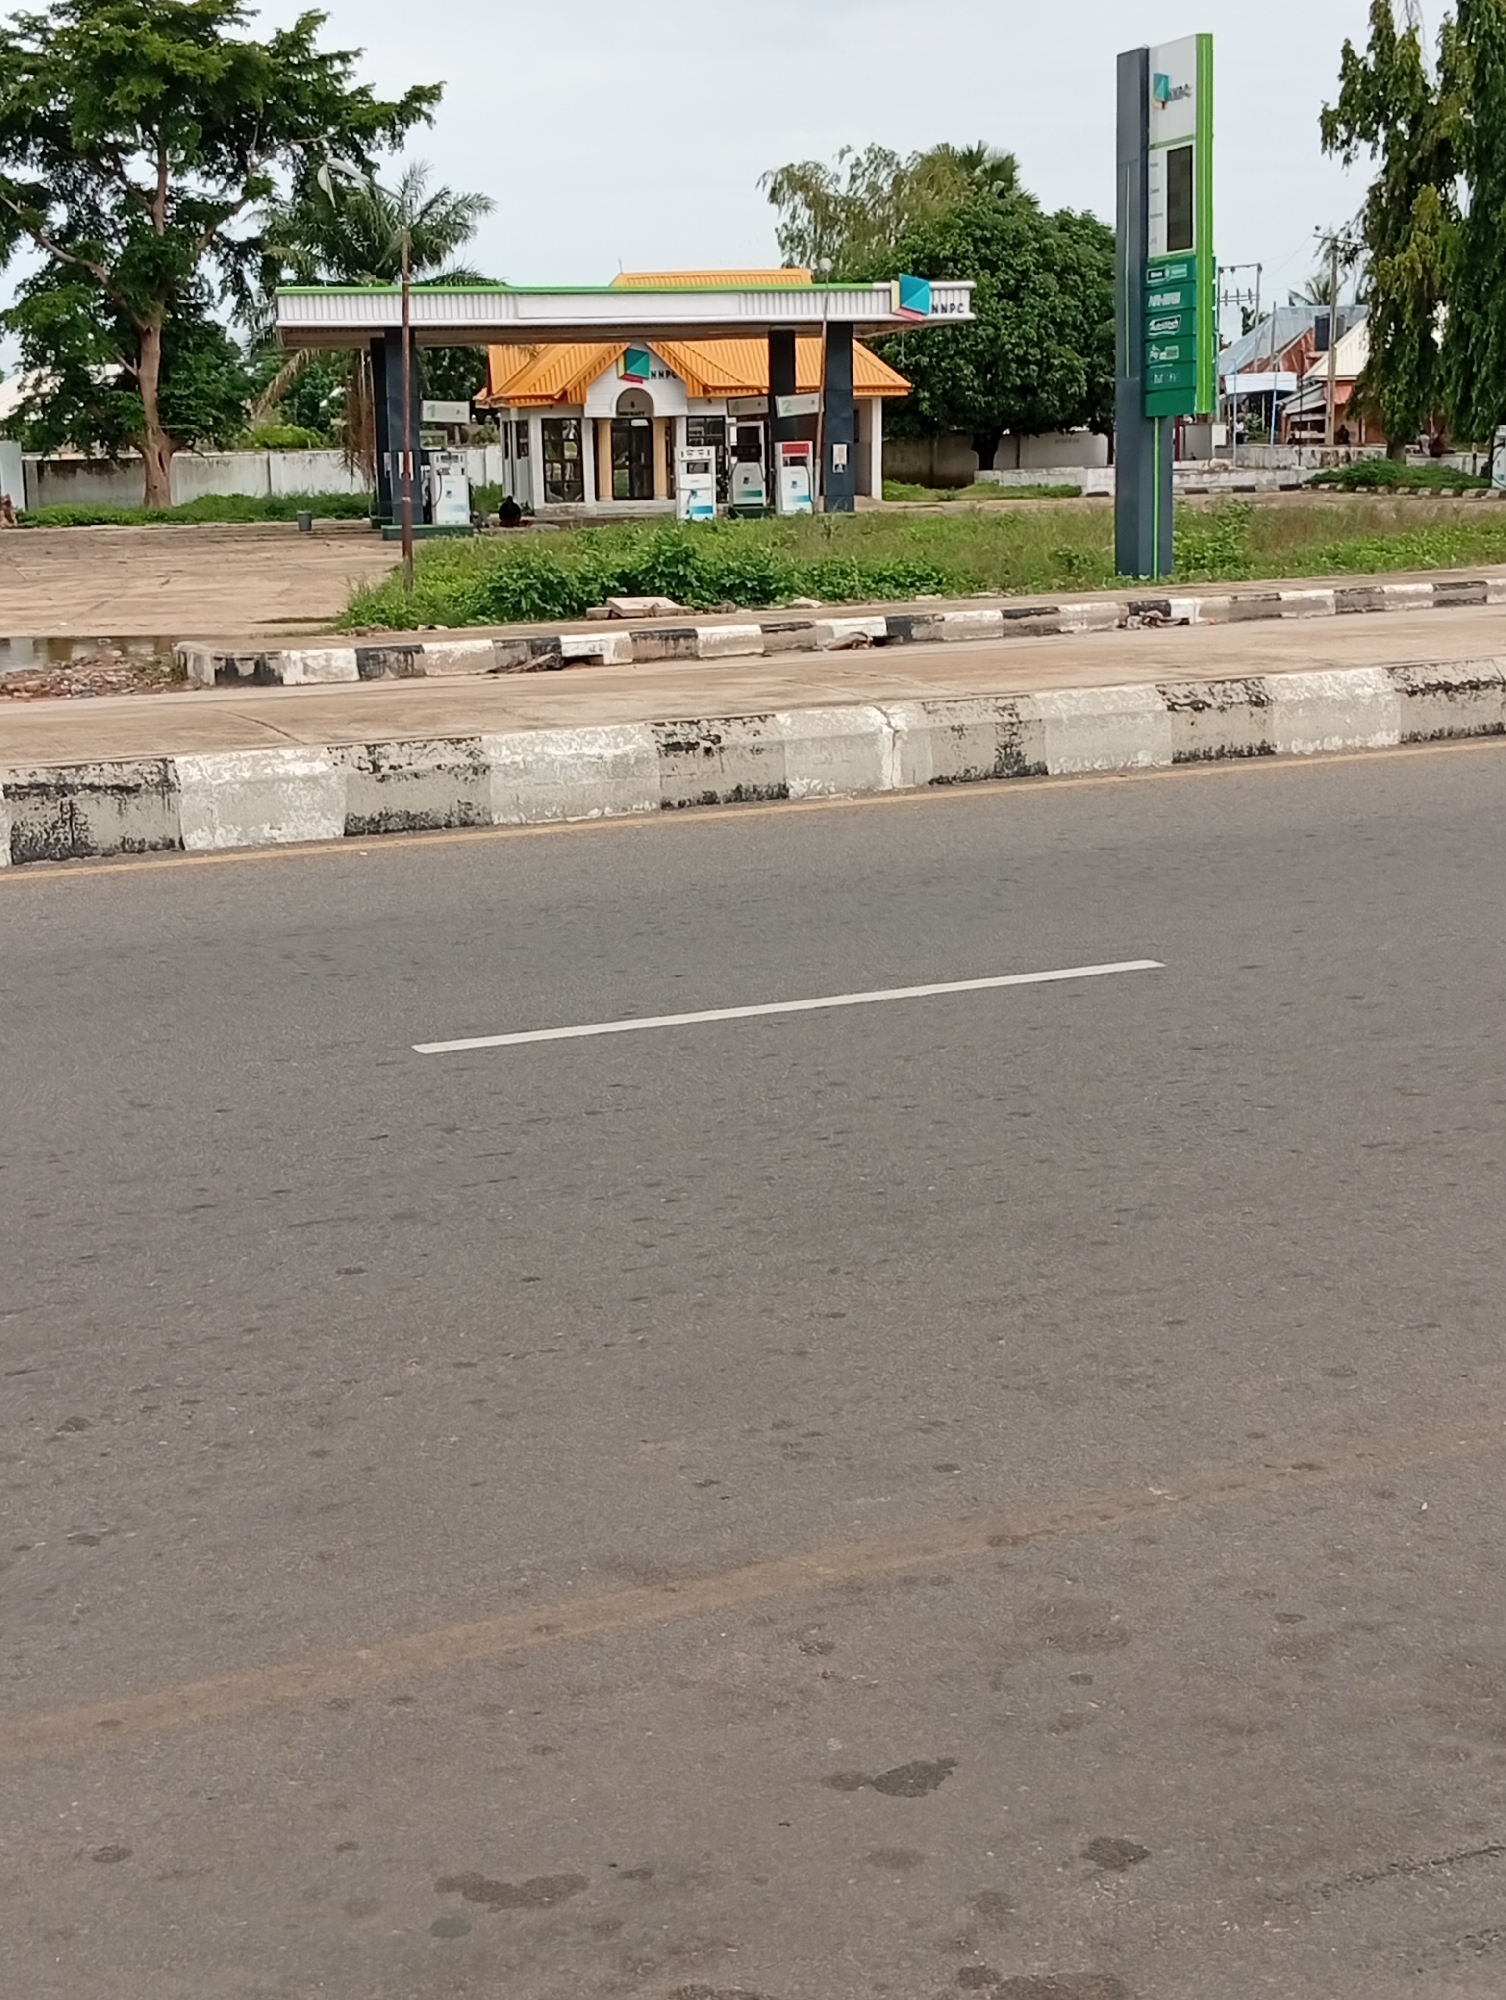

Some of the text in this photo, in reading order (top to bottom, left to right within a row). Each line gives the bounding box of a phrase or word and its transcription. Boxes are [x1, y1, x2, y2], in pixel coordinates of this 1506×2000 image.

[931, 303, 965, 314] NNPC
[651, 370, 678, 379] NNPC
[427, 404, 437, 418] 1
[782, 400, 793, 413] 2
